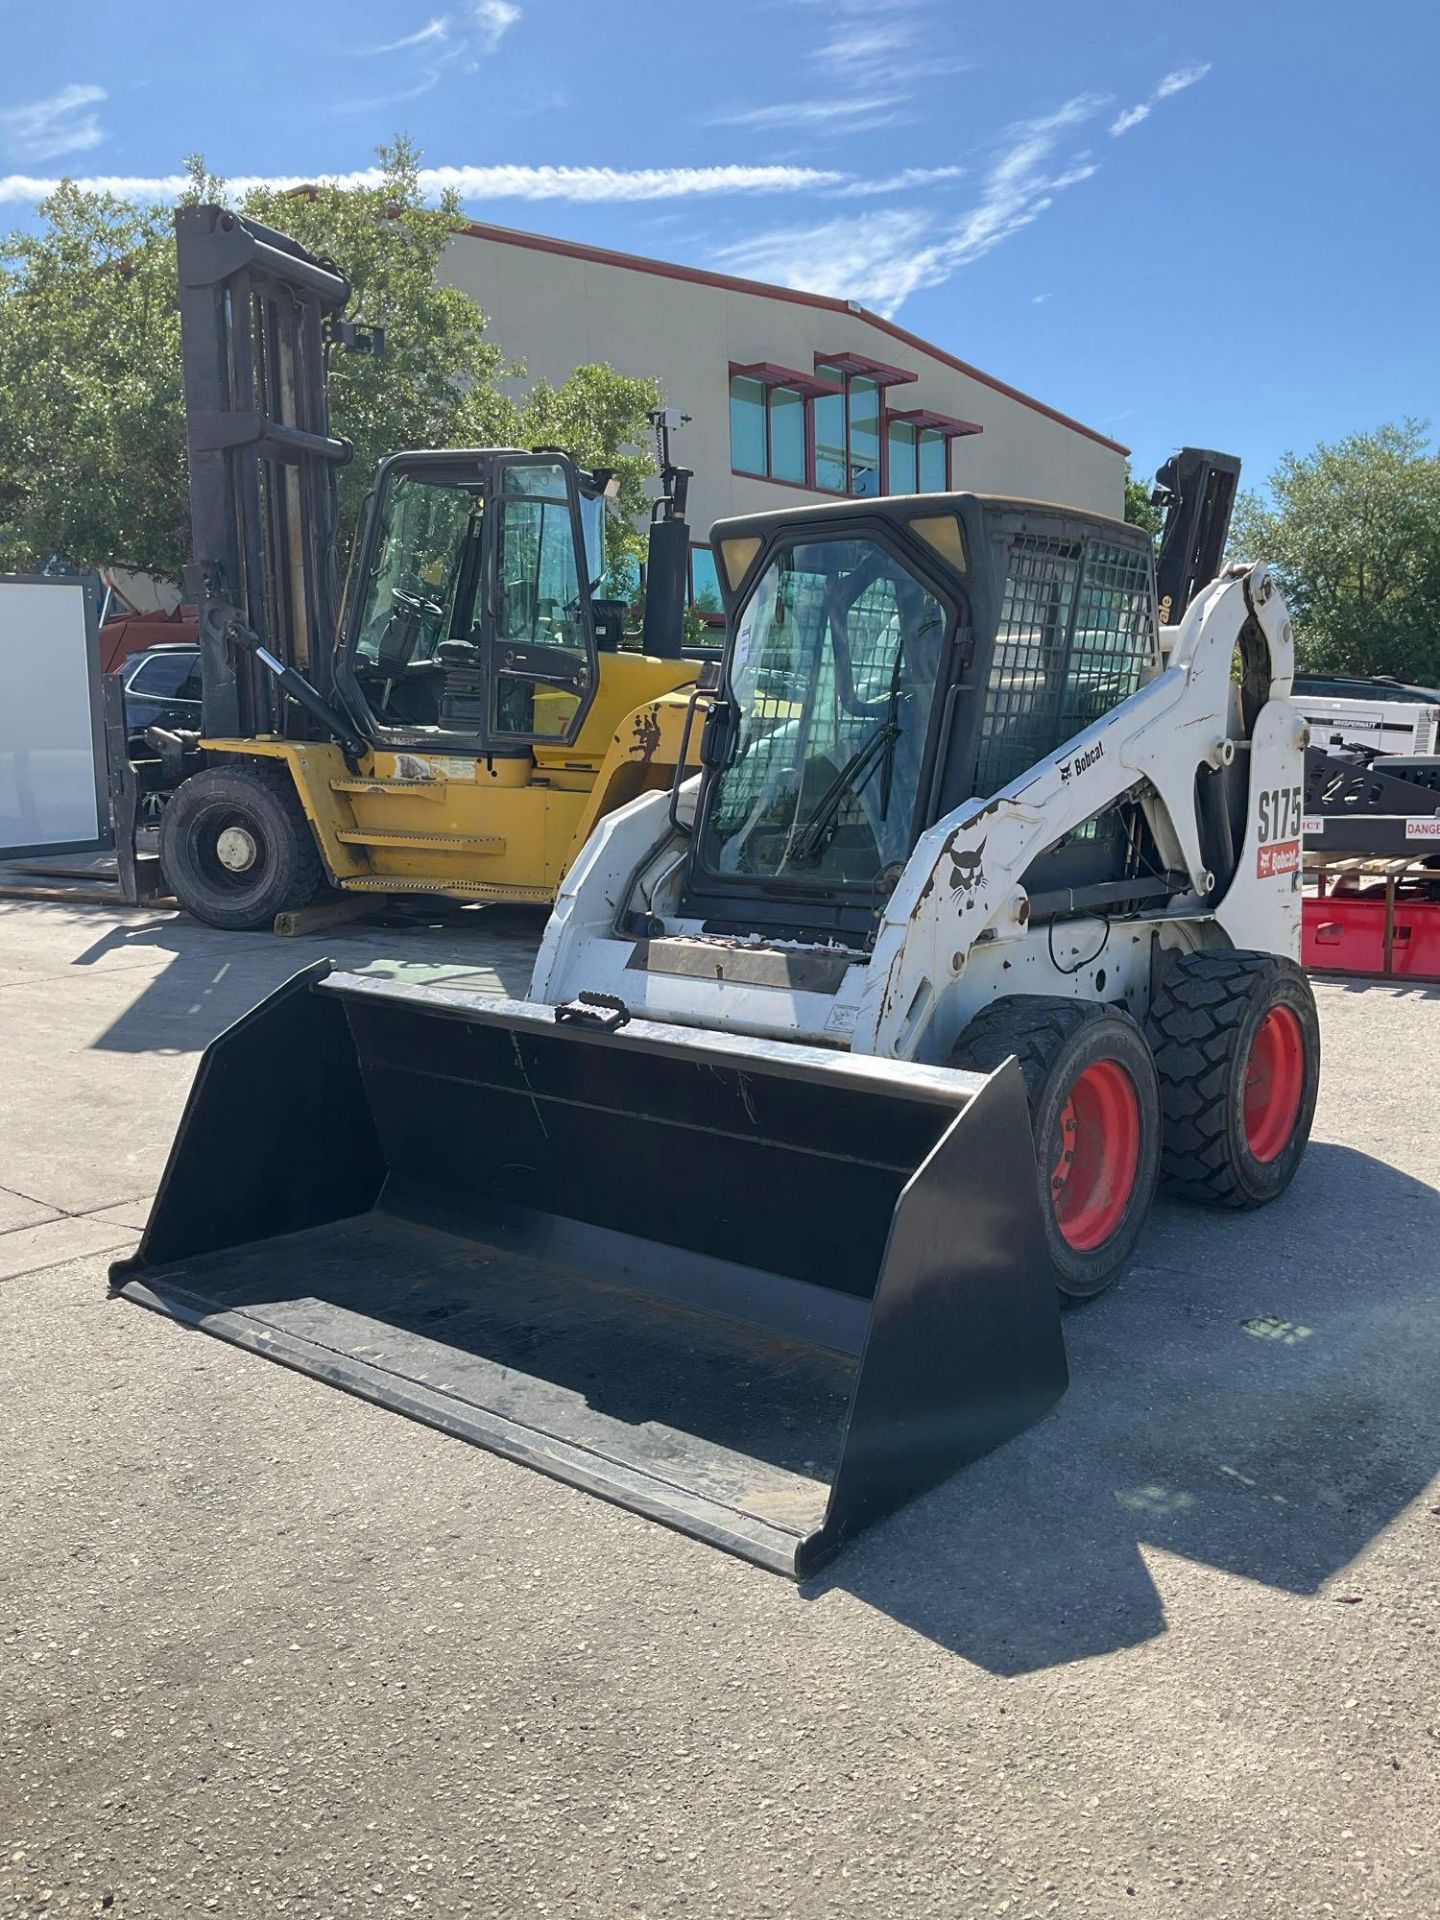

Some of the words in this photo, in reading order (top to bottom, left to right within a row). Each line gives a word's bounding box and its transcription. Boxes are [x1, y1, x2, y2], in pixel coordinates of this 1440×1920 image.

[1159, 595, 1172, 624] ale
[1333, 719, 1377, 729] WHISPERWATT
[1075, 741, 1104, 776] Bobcat
[1258, 786, 1302, 843] S175
[1408, 824, 1440, 834] DANGE
[1272, 848, 1297, 872] Bobcat
